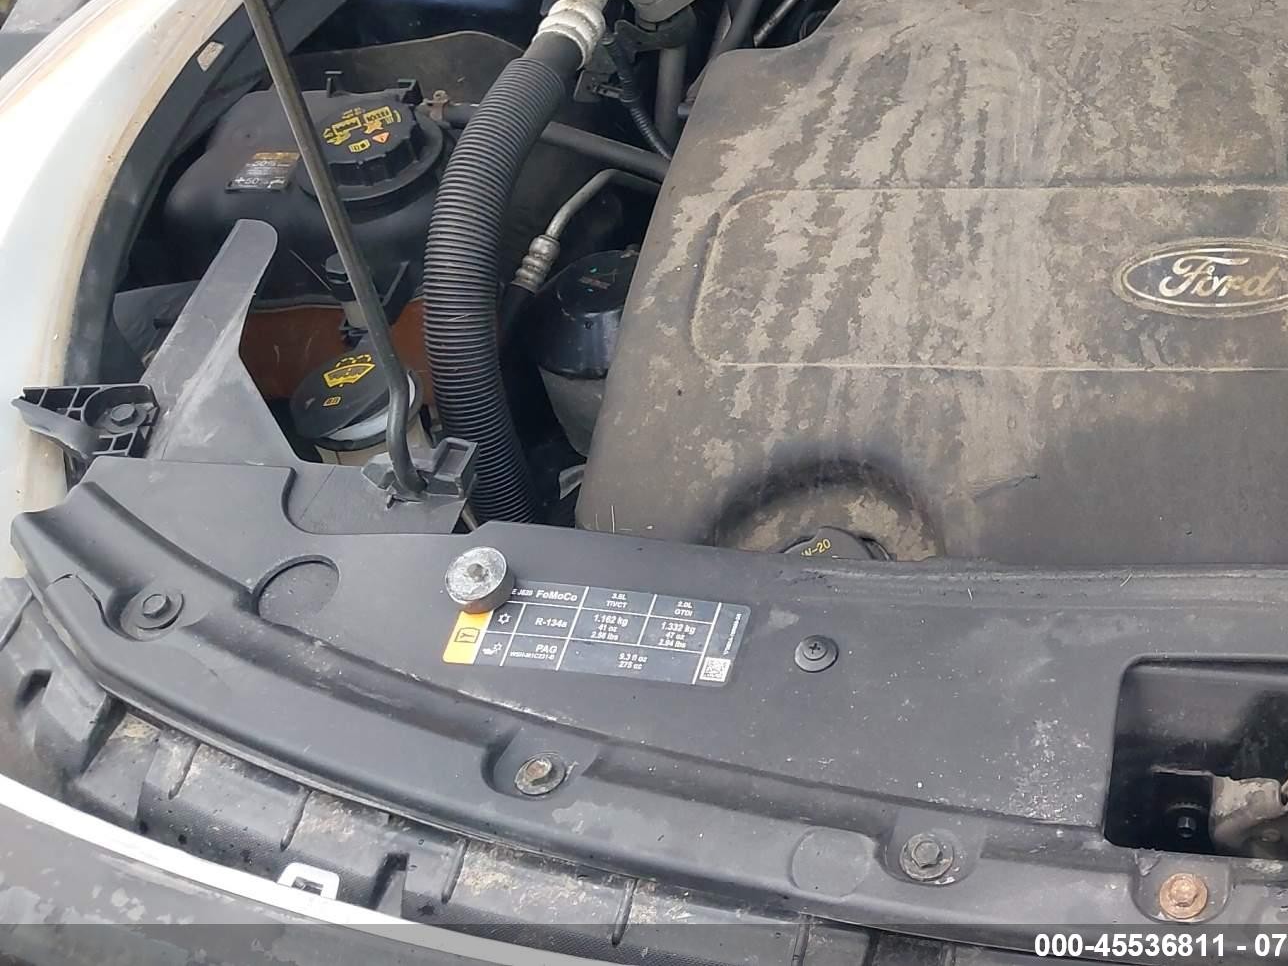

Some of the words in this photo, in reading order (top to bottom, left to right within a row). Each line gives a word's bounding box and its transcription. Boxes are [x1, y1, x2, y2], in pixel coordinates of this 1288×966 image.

[1158, 255, 1280, 297] Ford
[535, 589, 578, 602] FoMoCo
[534, 617, 568, 628] R-134a
[593, 614, 617, 624] 1.162
[617, 616, 629, 627] kg
[597, 623, 607, 632] 41
[607, 625, 618, 633] oz
[661, 621, 683, 632] 1.332
[684, 624, 697, 635] kg
[665, 631, 676, 640] 47
[536, 644, 558, 654] PAG
